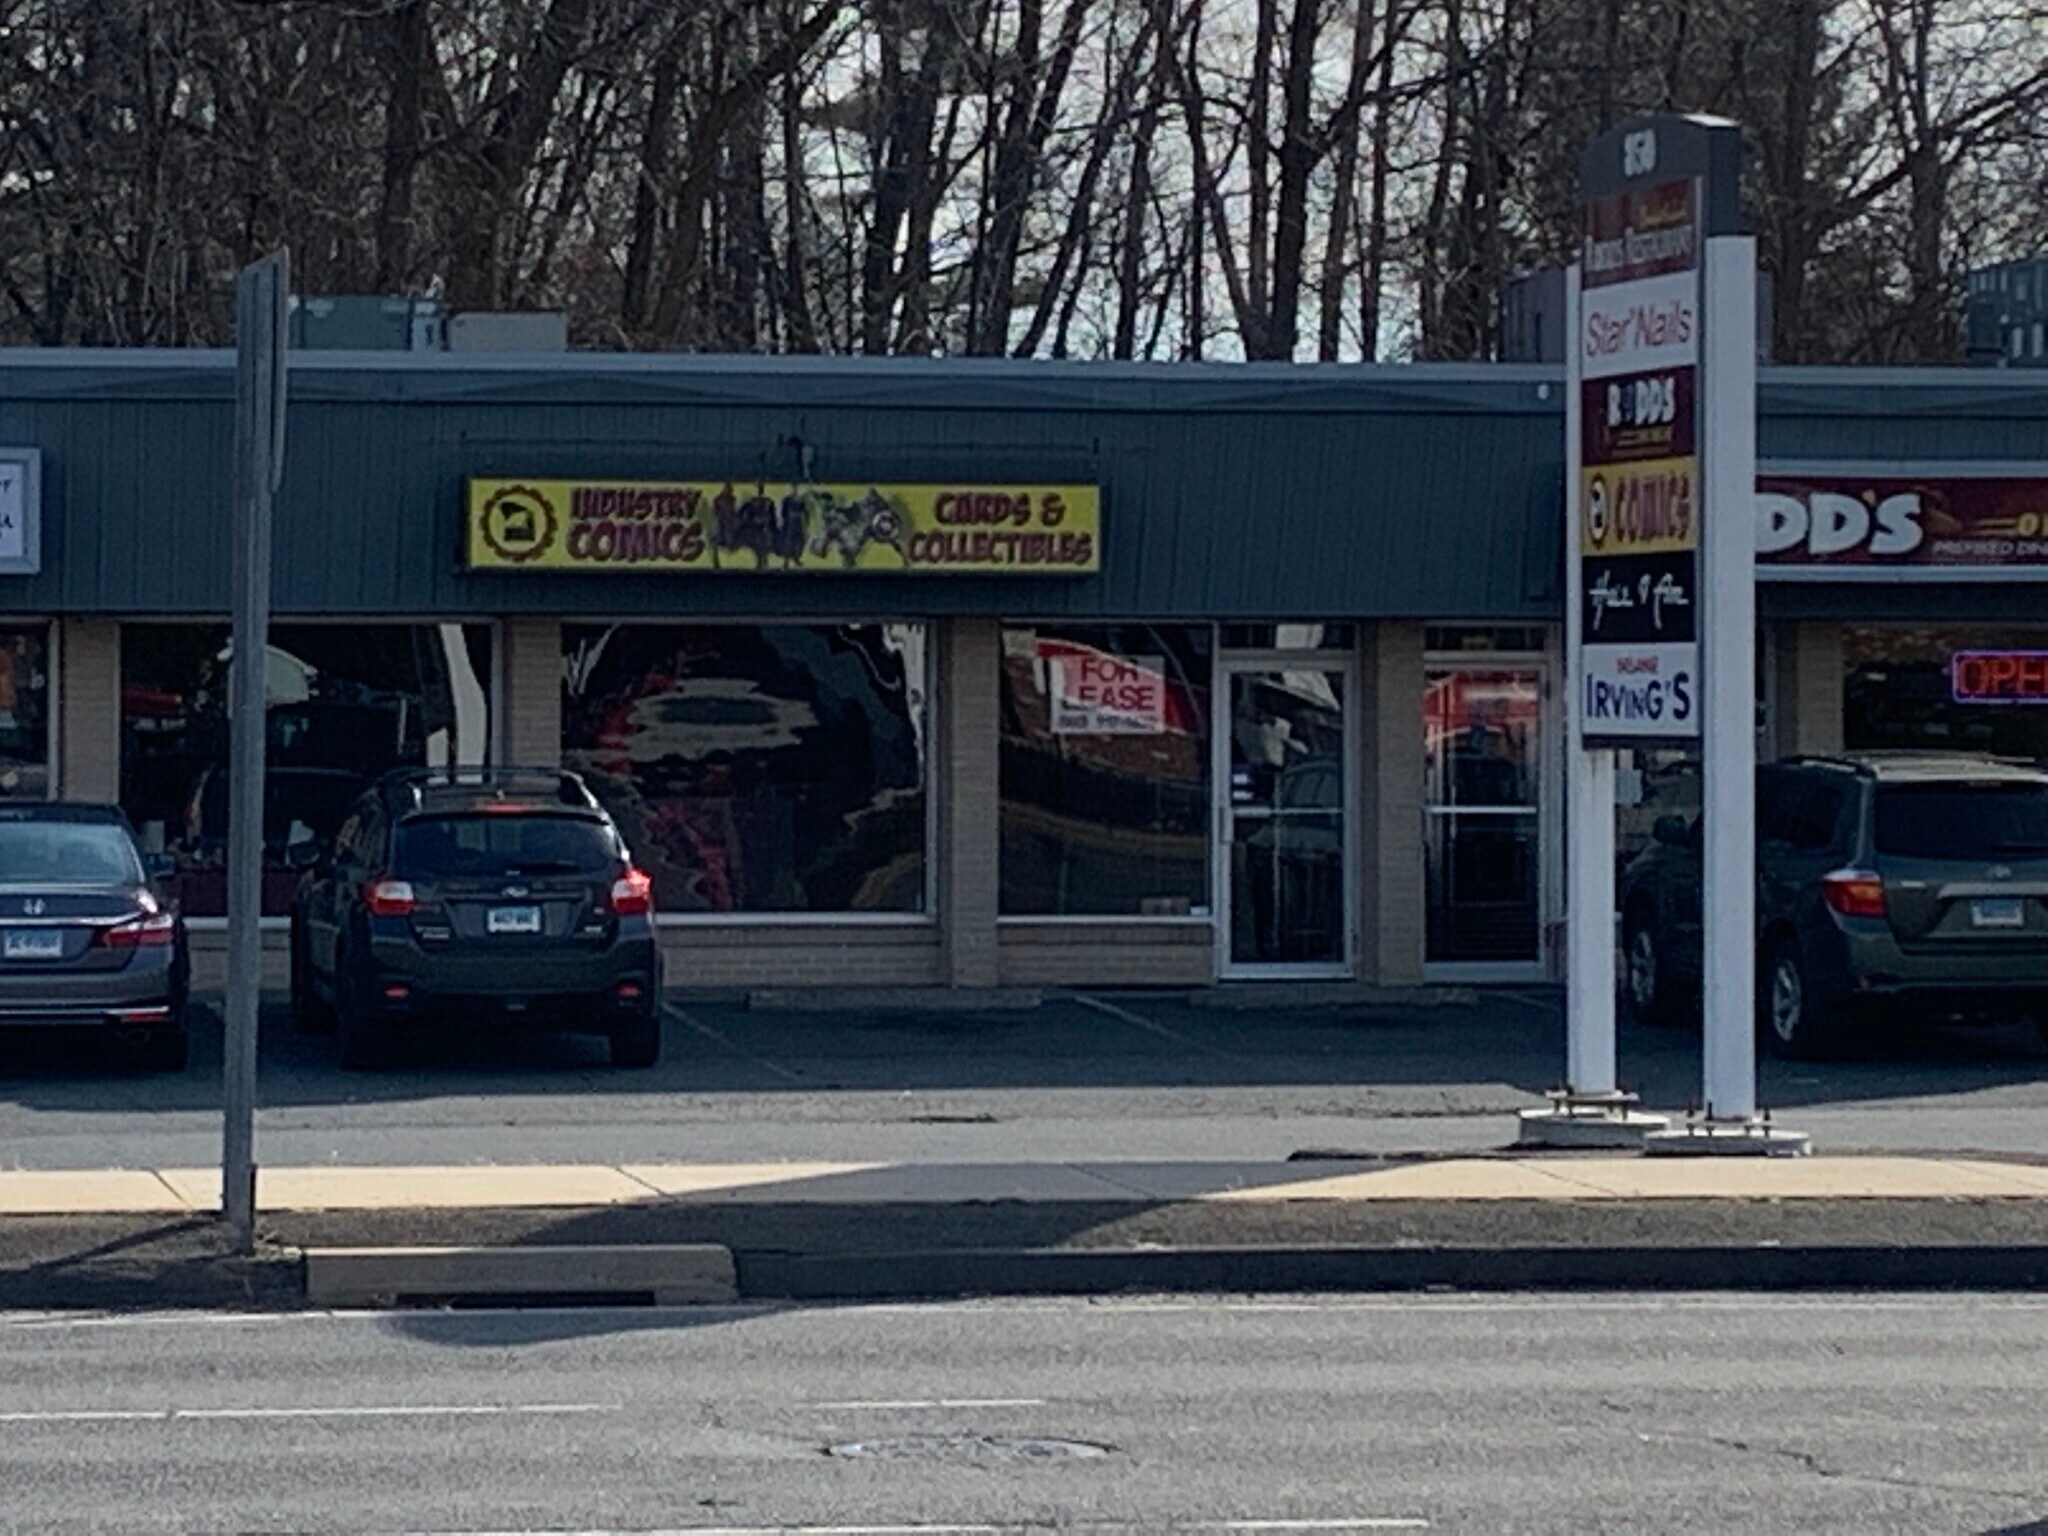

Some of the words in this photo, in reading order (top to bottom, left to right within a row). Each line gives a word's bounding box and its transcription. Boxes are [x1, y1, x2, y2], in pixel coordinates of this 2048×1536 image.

[570, 486, 702, 520] INDUSTRY
[933, 492, 1031, 526] CARDS
[1039, 492, 1067, 527] &
[1615, 470, 1690, 543] COMICS
[567, 520, 705, 561] COMICS
[908, 531, 1093, 565] COLLECTIBLES
[1957, 659, 2048, 695] OPE
[1585, 671, 1691, 721] IRVING'S
